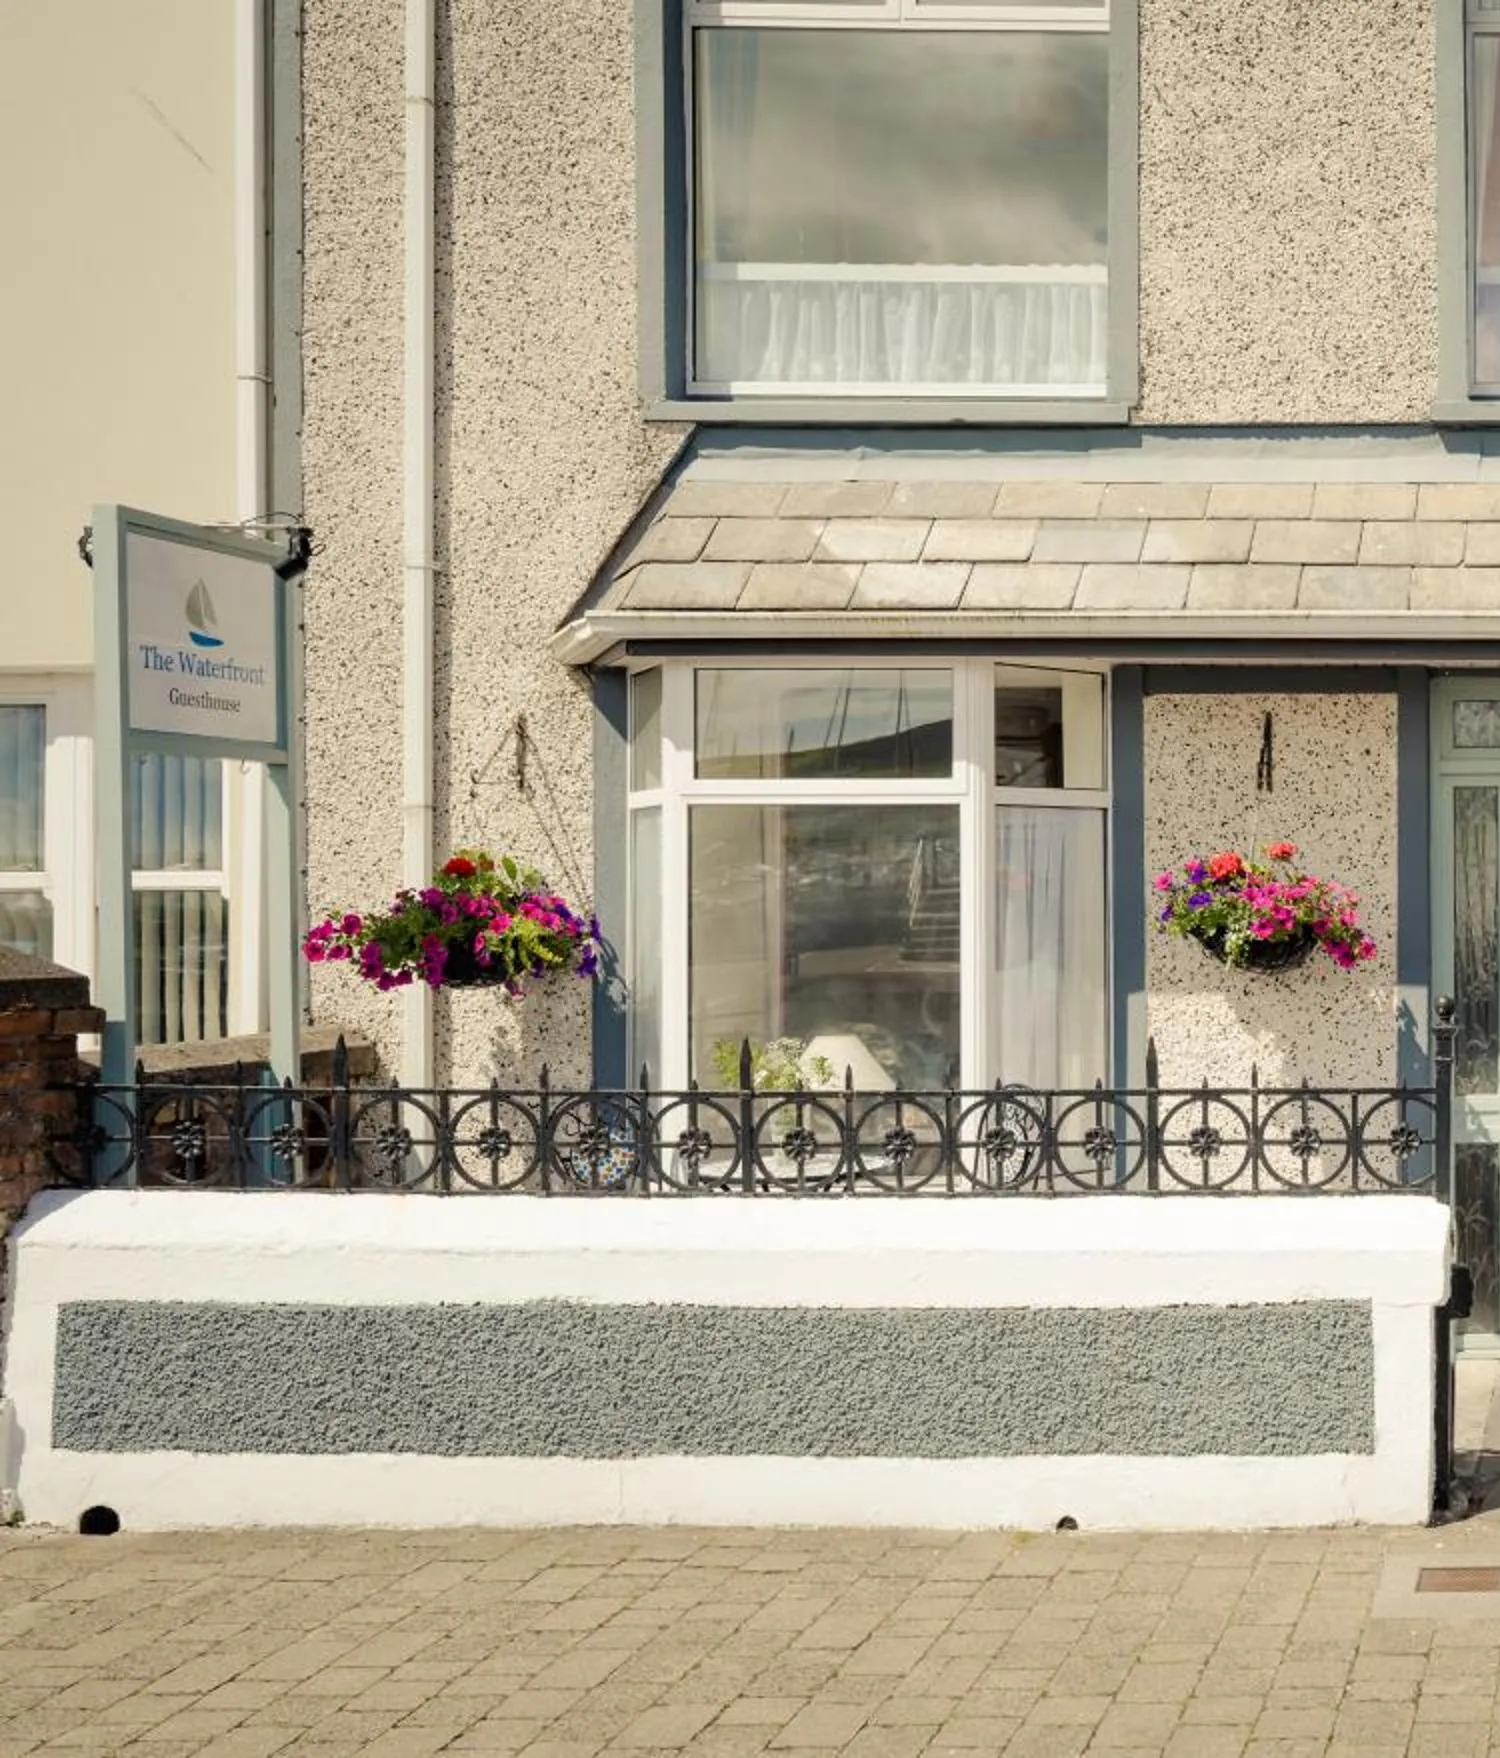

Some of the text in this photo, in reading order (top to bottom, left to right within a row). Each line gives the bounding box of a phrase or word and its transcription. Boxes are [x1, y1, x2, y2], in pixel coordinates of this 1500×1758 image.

[139, 644, 265, 686] The Waterfront
[169, 687, 241, 713] Guesthouse
